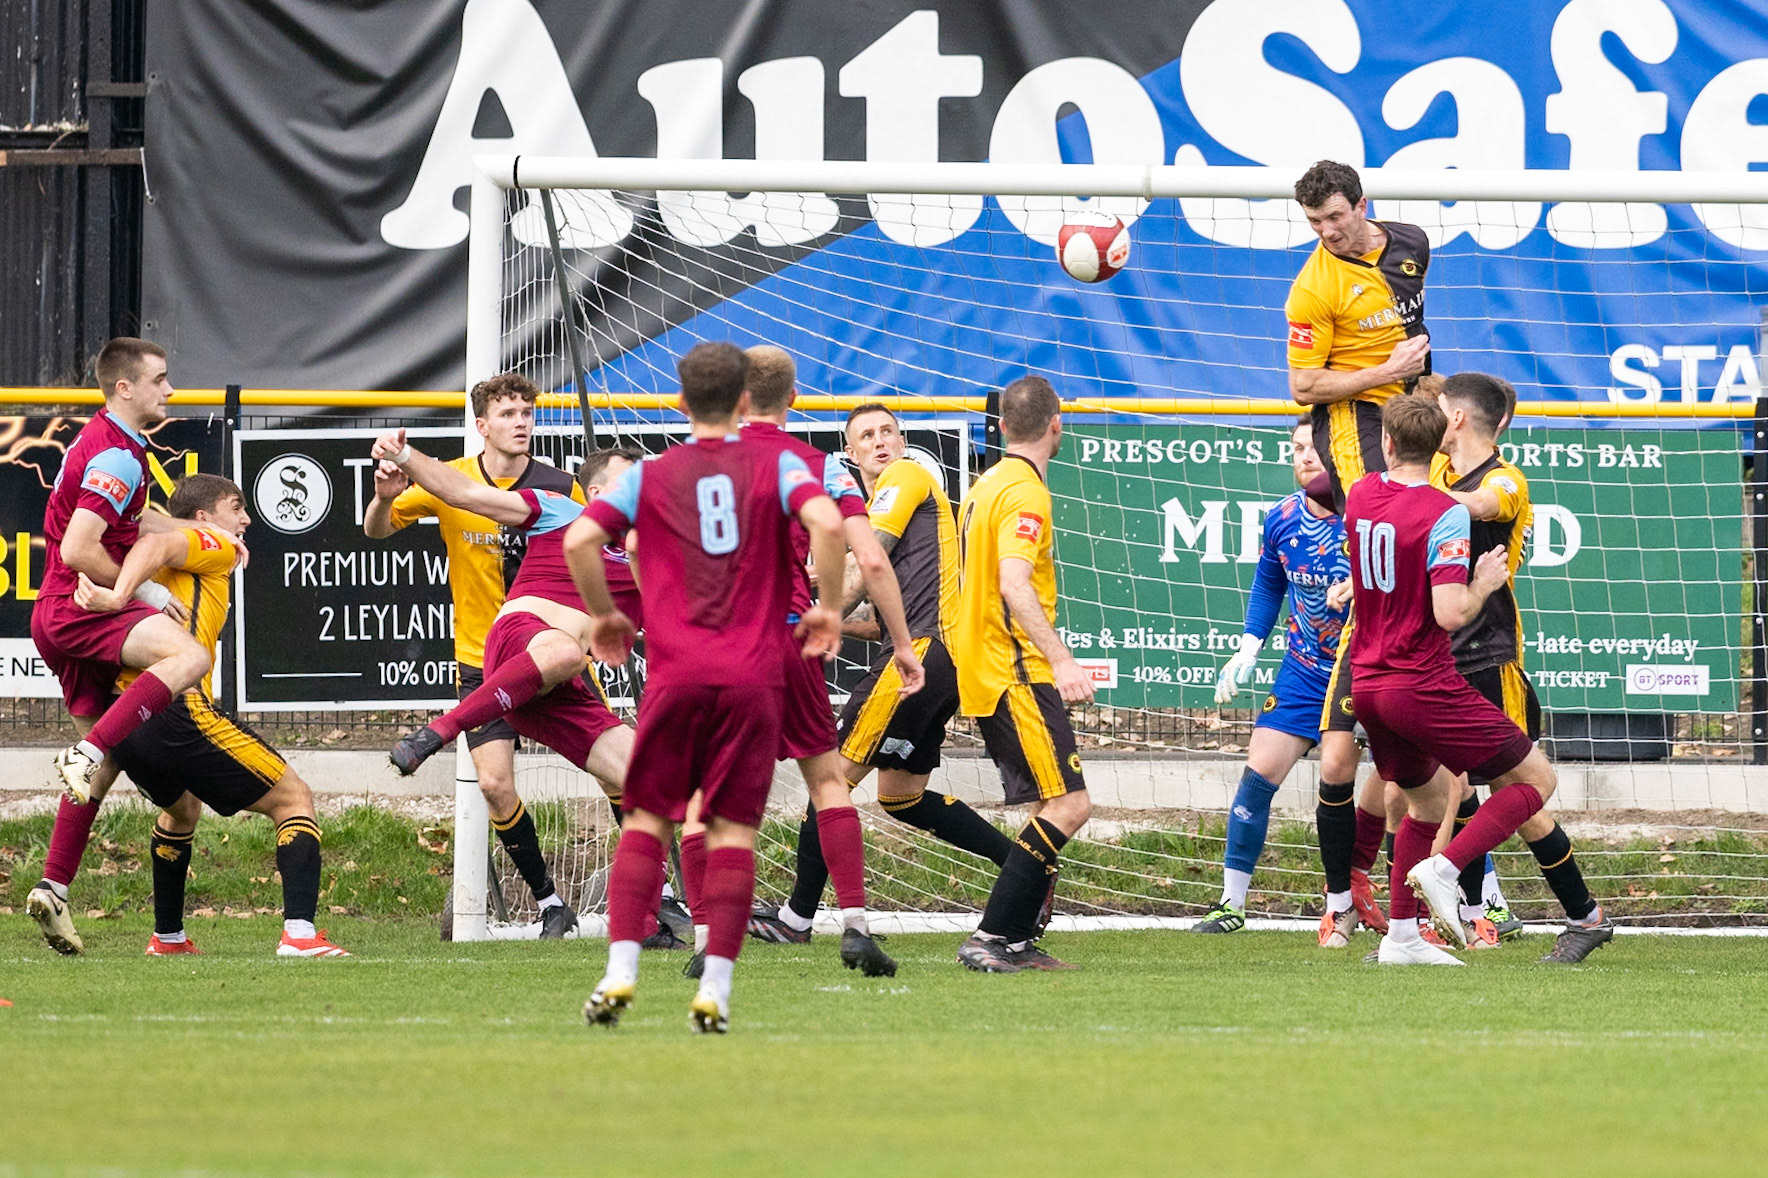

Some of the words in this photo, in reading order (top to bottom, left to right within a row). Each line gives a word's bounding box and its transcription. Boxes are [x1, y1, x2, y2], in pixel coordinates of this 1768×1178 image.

[1081, 439, 1264, 464] PRESCOT'S
[1499, 442, 1585, 468] ORTS
[1597, 444, 1663, 468] BAR
[696, 474, 739, 555] 8
[1355, 518, 1395, 594] 10
[284, 551, 414, 587] PREMIUM
[319, 606, 336, 642] 2
[343, 604, 455, 641] LEYLAN
[1057, 626, 1093, 649] les
[1098, 628, 1117, 649] &
[1123, 627, 1200, 650] Elixirs
[1207, 627, 1256, 650] fro
[1588, 633, 1699, 661] everyday
[378, 661, 419, 686] 10%
[423, 661, 457, 686] OFF
[1133, 665, 1172, 683] 10%
[1176, 666, 1214, 684] OFF
[1535, 670, 1611, 688] TICKET
[1658, 674, 1699, 686] SPORT
